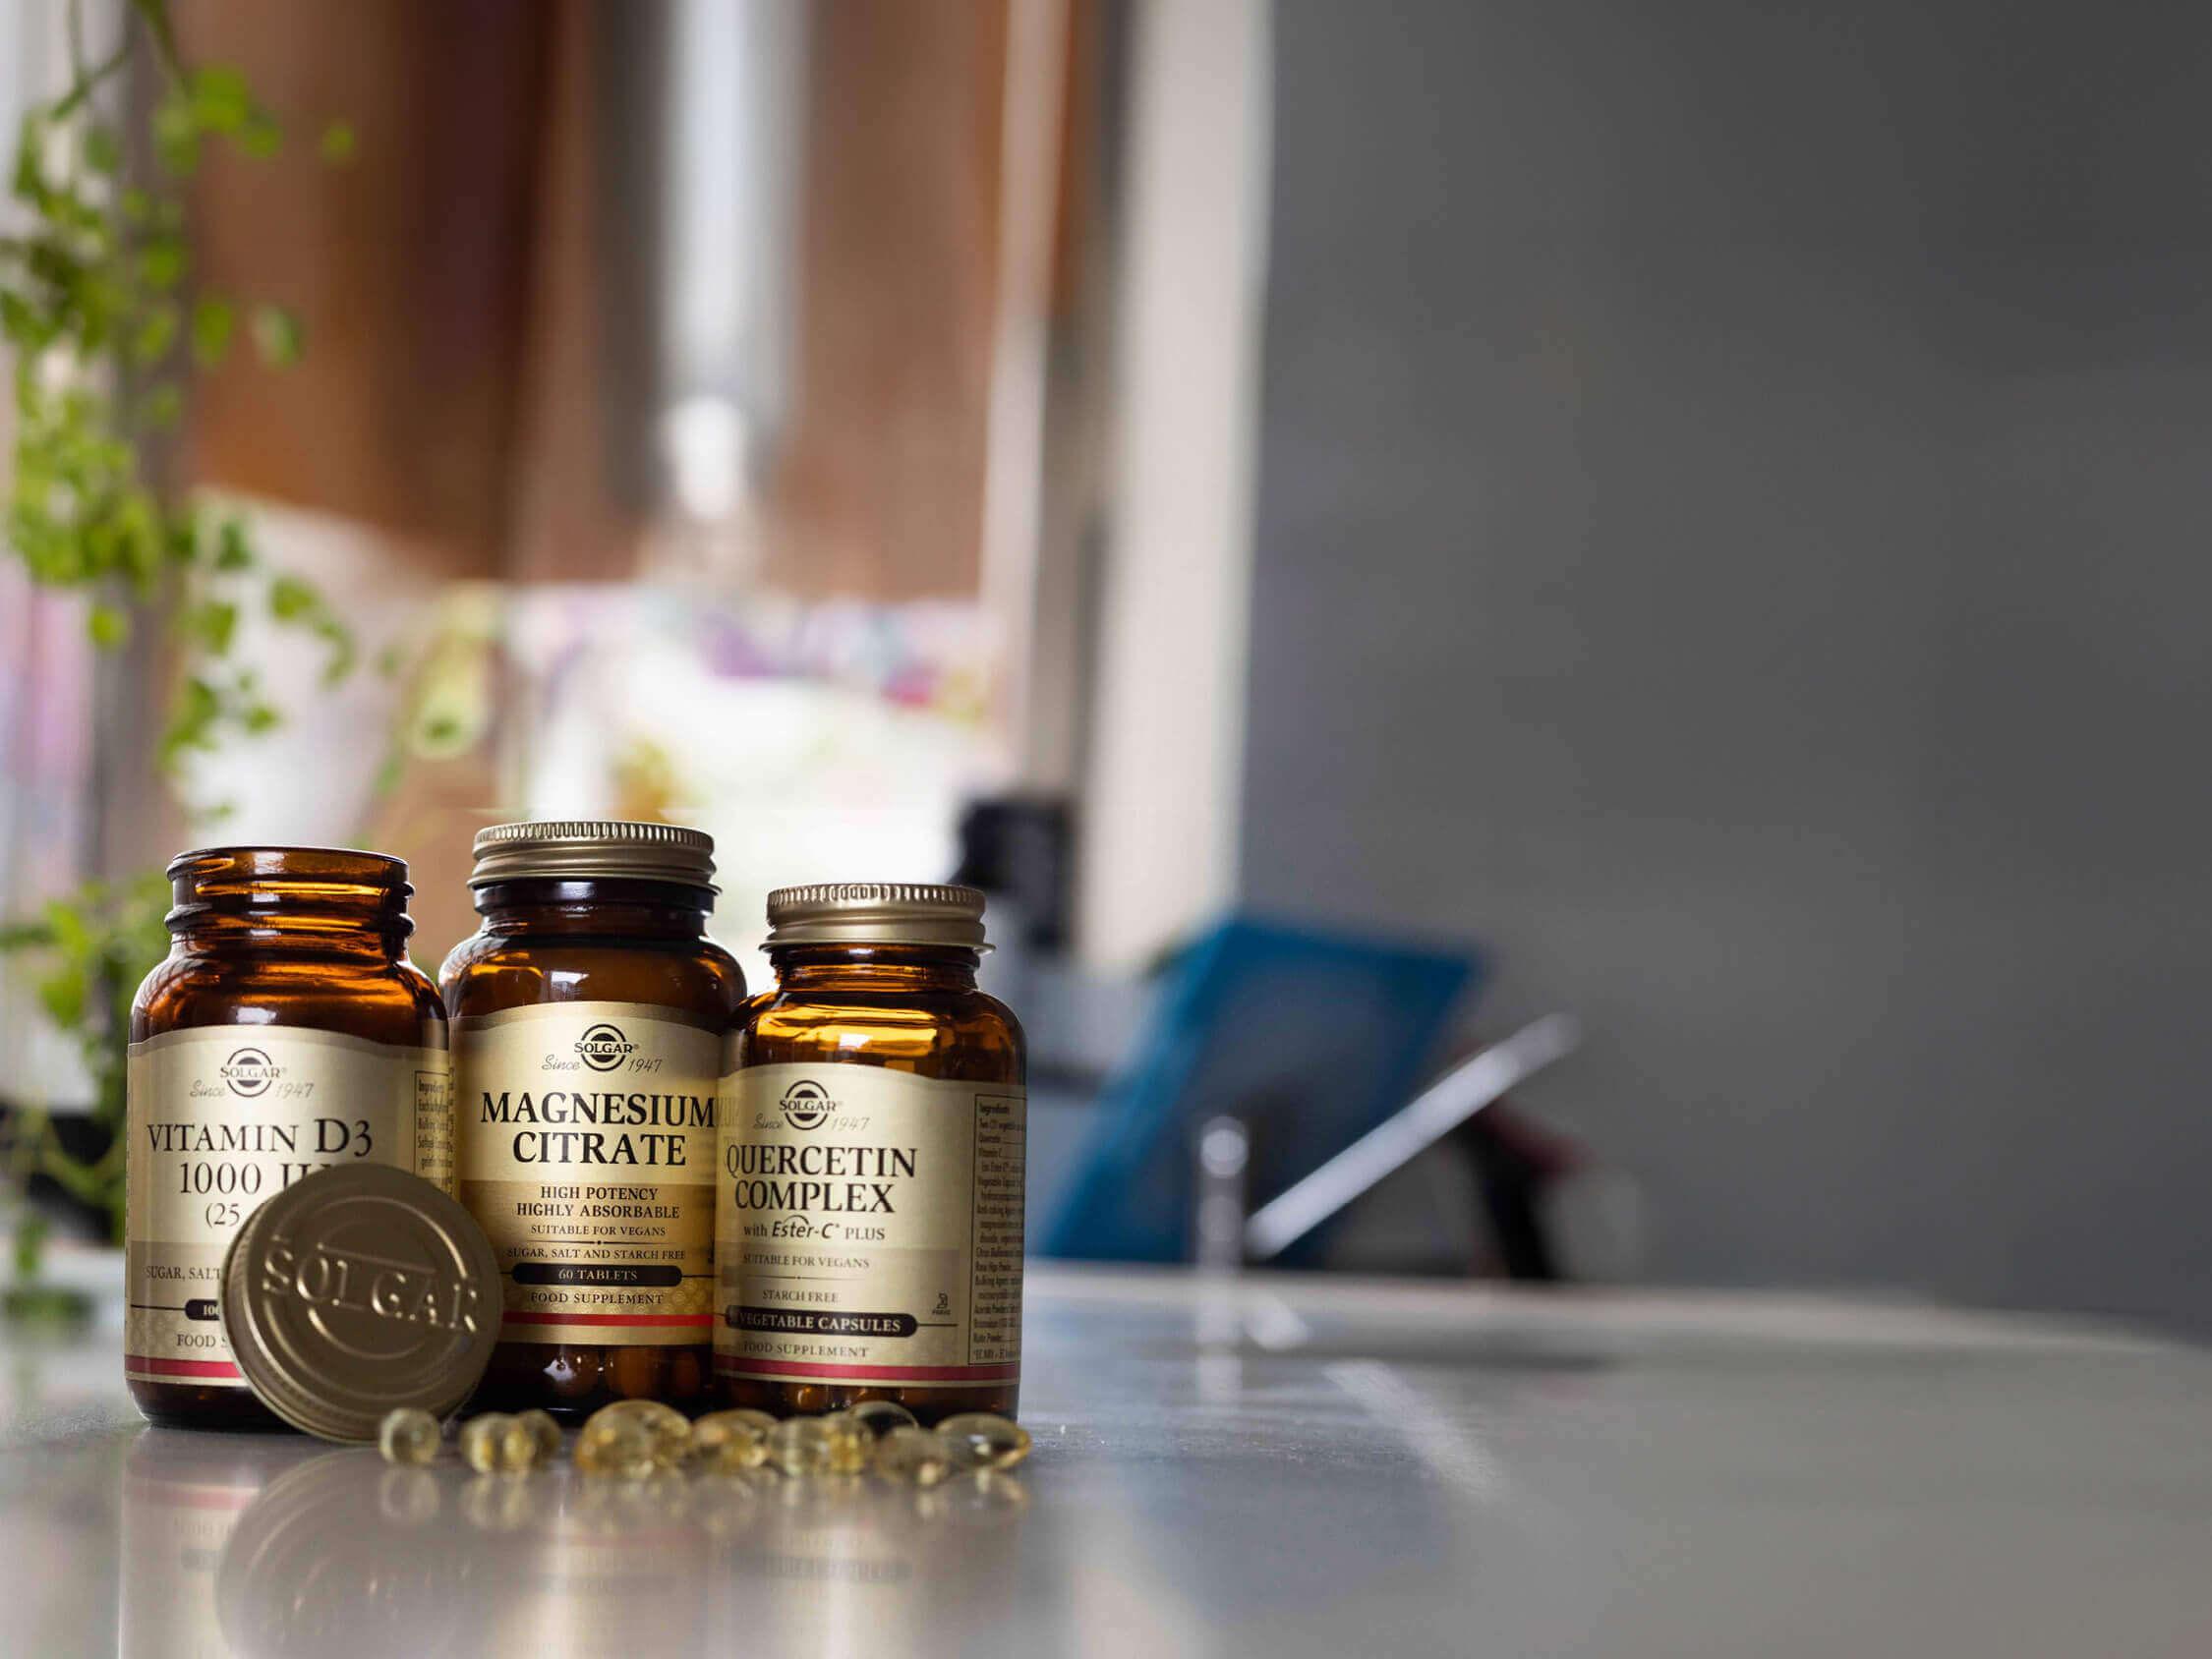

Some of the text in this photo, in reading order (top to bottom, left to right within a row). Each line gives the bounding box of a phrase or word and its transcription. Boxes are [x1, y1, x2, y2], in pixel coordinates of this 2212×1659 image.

[574, 1042, 633, 1054] SOLGAR
[542, 1054, 662, 1073] Since 1947
[220, 1066, 281, 1078] SOLGAR
[275, 1082, 314, 1099] 1947
[481, 1092, 716, 1128] MAGNESIUM
[779, 1100, 837, 1112] SOLGAR
[832, 1116, 870, 1130] 1947
[146, 1118, 373, 1158] VITAMIN D3
[513, 1131, 686, 1167] CITRATE
[727, 1144, 919, 1178] QUERCETIN
[180, 1162, 262, 1194] 1000
[540, 1185, 659, 1201] HIGH POTENCY
[734, 1179, 896, 1214] COMPLEX
[205, 1202, 240, 1229] (25
[516, 1202, 680, 1219] HIGHLY ABSORBABLE
[530, 1225, 667, 1236] SUITABLE FOR VEGANS
[743, 1223, 768, 1237] with
[844, 1228, 886, 1240] PLUS
[507, 1248, 686, 1260] SUGAR, SALT AND STARCH FREE
[742, 1254, 870, 1269] SUITABLE FOR VEGANS
[146, 1265, 186, 1281] SUGAR,
[557, 1268, 638, 1282] 60 TABLETS
[530, 1292, 665, 1305] FOOD SUPPLEMENT
[762, 1289, 841, 1303] STARCH FREE
[739, 1311, 902, 1333] VEGETABLE CAPSULES
[176, 1334, 216, 1347] FOOD
[776, 1344, 869, 1358] SUPPLEMENT
